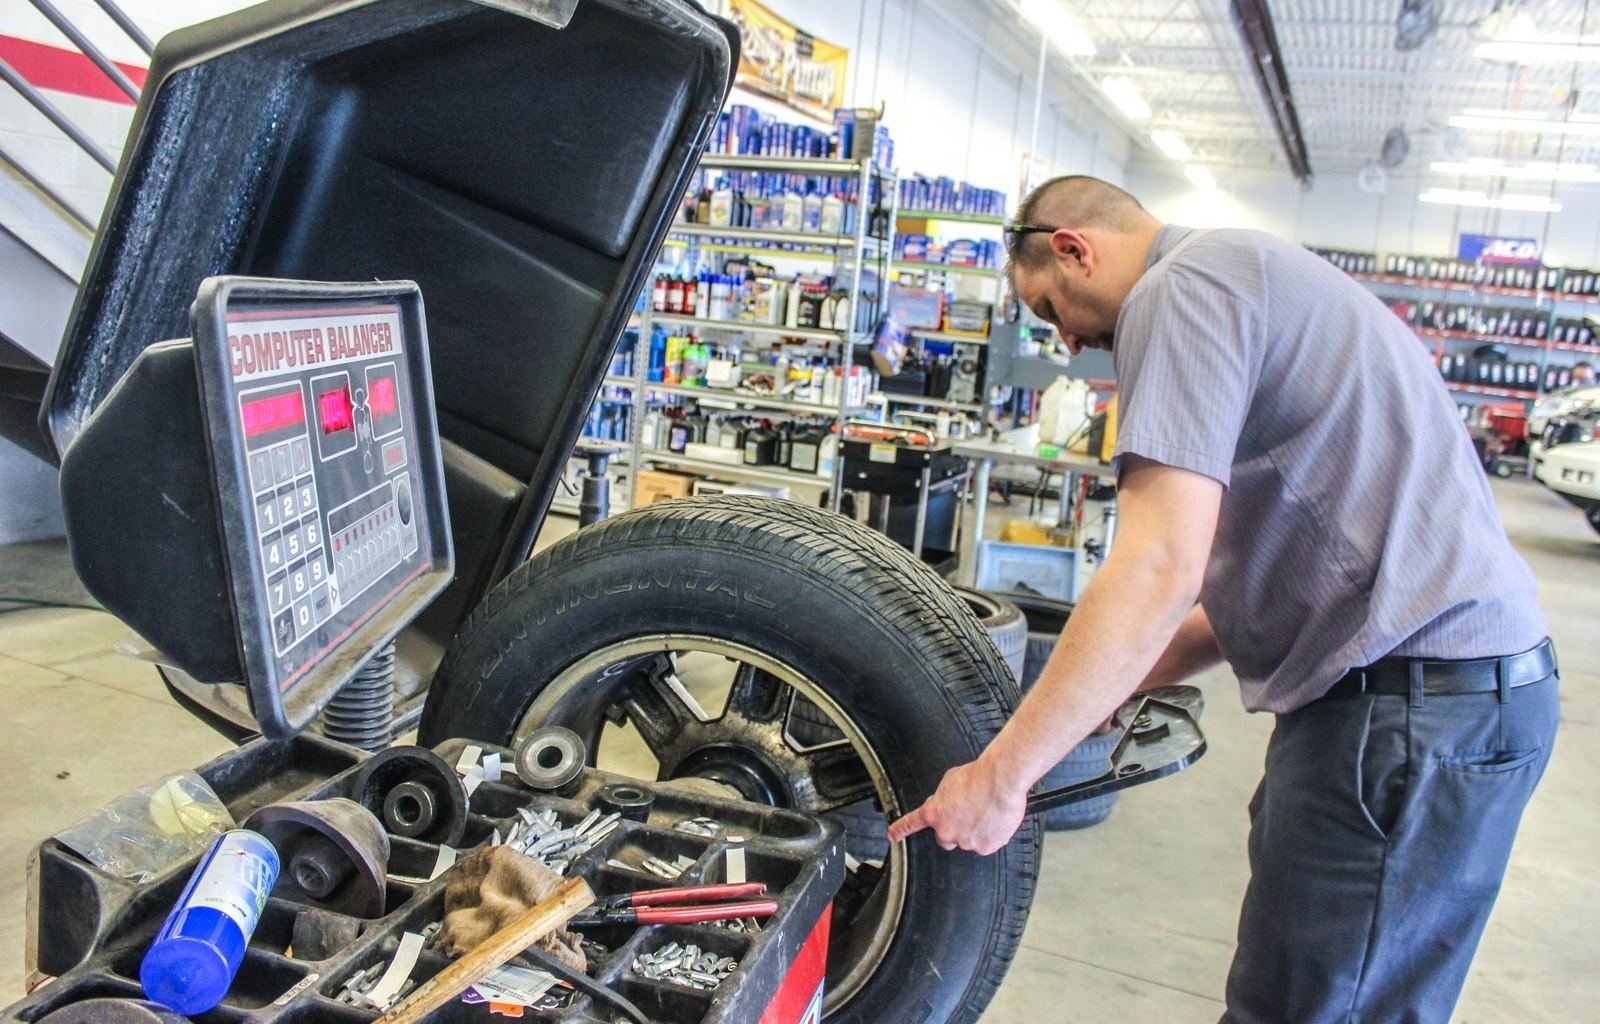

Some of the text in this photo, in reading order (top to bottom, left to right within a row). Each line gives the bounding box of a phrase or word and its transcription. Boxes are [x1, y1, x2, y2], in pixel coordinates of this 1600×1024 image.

[229, 322, 393, 376] COMPUTER BALANCER
[264, 504, 274, 525] 1
[283, 496, 294, 517] 2
[302, 488, 312, 507] 3
[269, 544, 280, 564] 4
[289, 534, 299, 555] 5
[307, 525, 317, 544] 6
[274, 584, 284, 606] 7
[294, 572, 305, 592] 8
[312, 561, 322, 580] 9
[299, 605, 309, 626] 0
